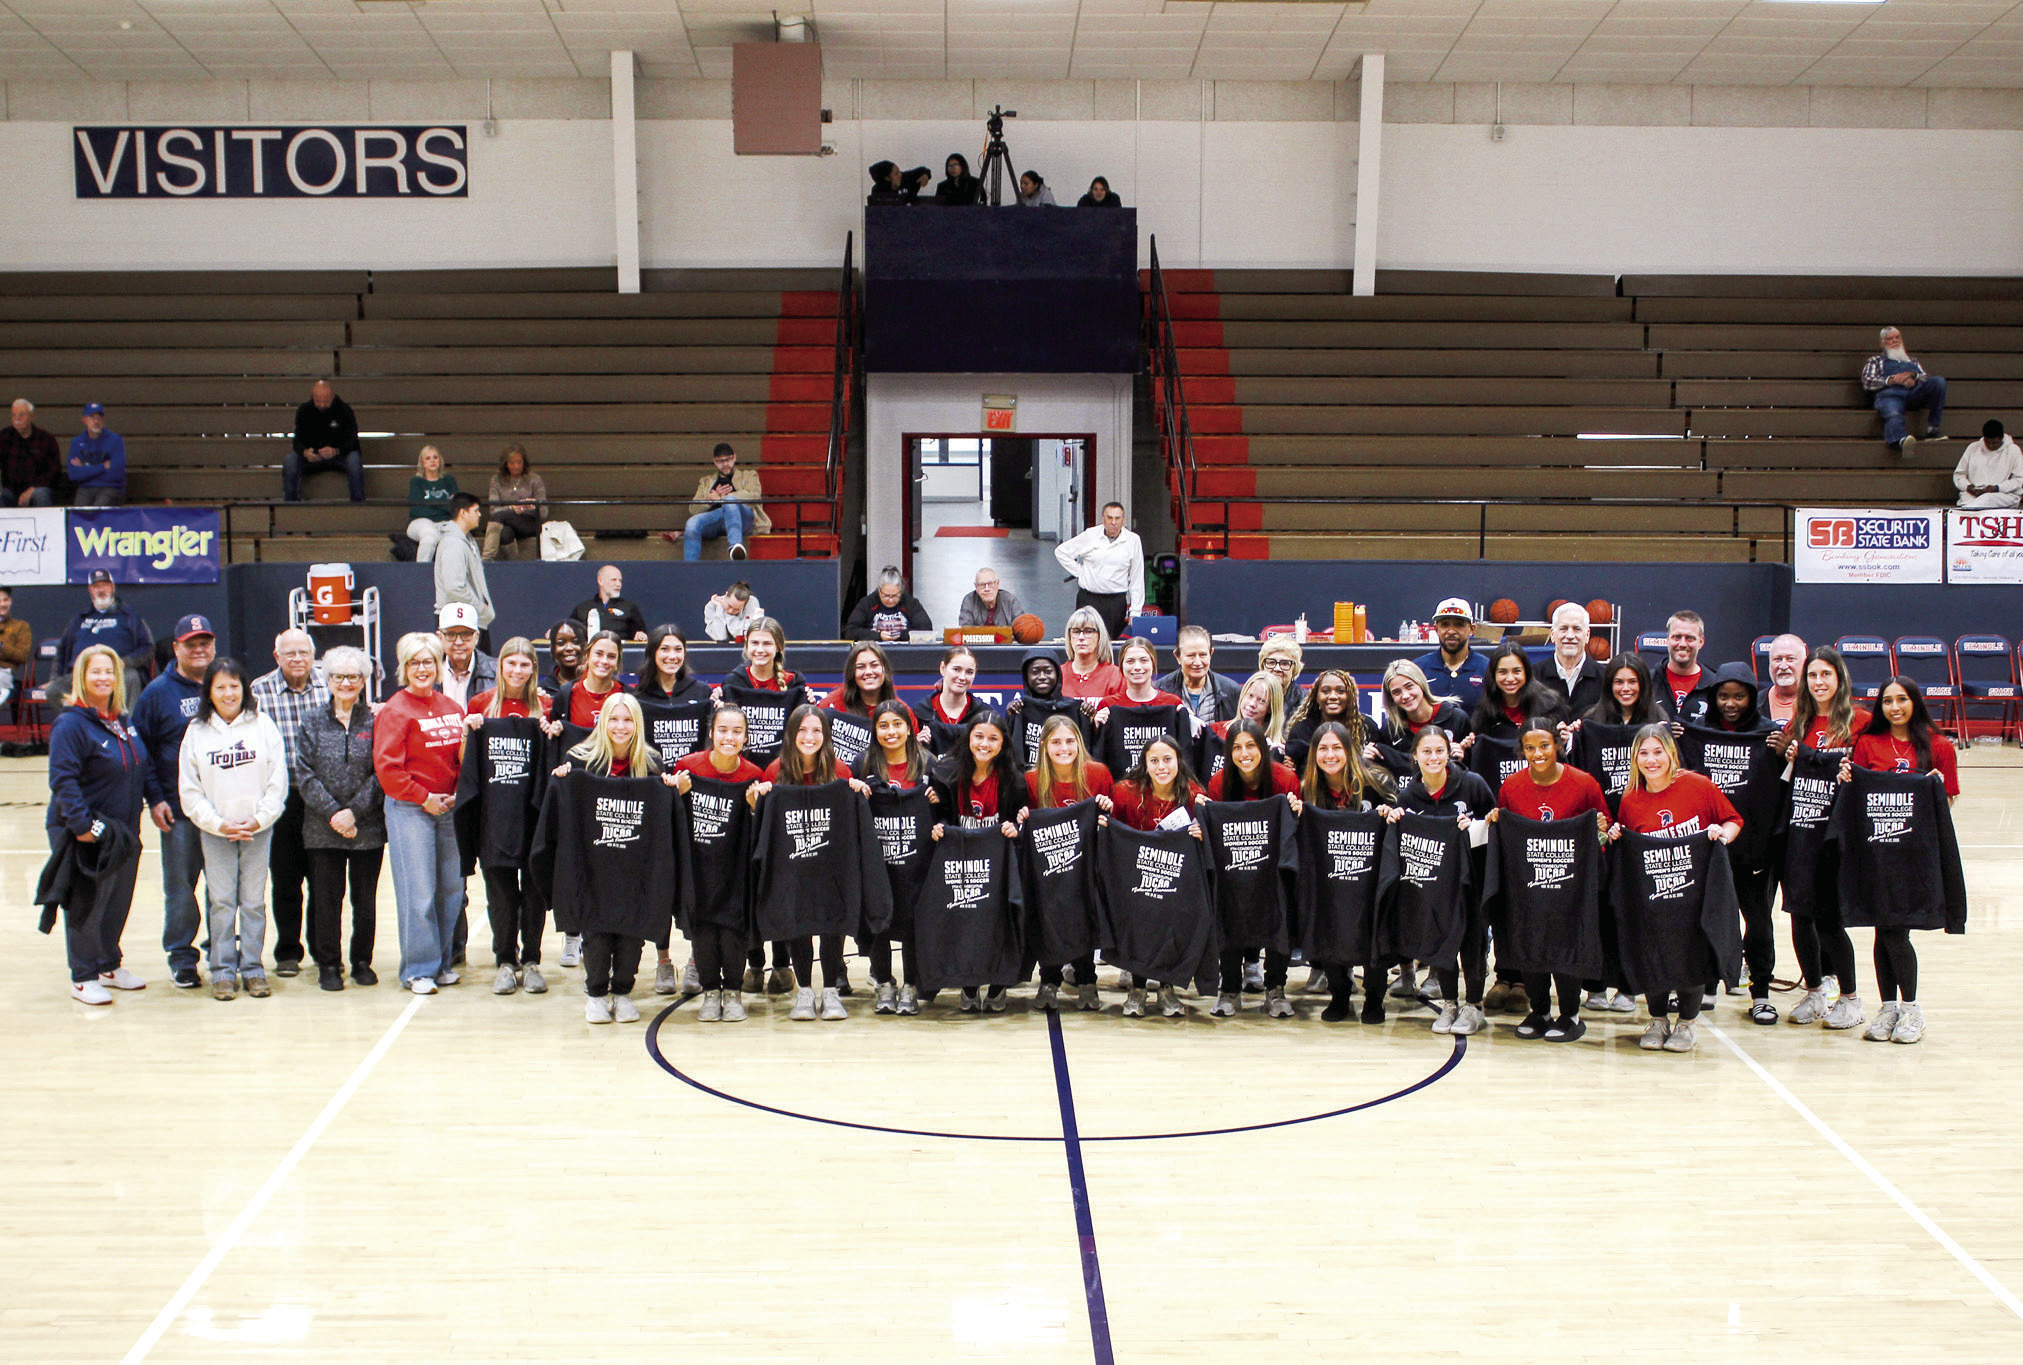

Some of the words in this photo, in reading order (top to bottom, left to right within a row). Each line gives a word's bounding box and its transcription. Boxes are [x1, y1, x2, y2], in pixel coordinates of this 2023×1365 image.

[76, 128, 467, 195] VISITORS
[987, 410, 1013, 430] EXIT
[1858, 519, 1928, 534] SECURITY
[1, 530, 49, 557] First
[74, 525, 213, 570] Wrangler
[1858, 535, 1890, 547] STATE
[1893, 535, 1928, 547] BANK
[316, 585, 333, 605] G
[457, 607, 464, 619] S
[191, 617, 203, 631] S
[962, 634, 995, 644] POSSESSION
[1643, 637, 1669, 647] SEMIN
[1963, 641, 2004, 651] SEMINOLE
[1842, 642, 1885, 652] SEMINOLE
[1900, 643, 1943, 653] SEMINOLE
[1926, 686, 1952, 696] STATE
[1988, 687, 2014, 697] STATE
[653, 719, 699, 733] SEMINOLE
[832, 729, 845, 739] STATE
[207, 750, 256, 767] Trojans
[1704, 744, 1751, 759] SEMINOLE
[1722, 757, 1750, 765] COLLEGE
[597, 797, 645, 815] SEMINOLE
[1867, 793, 1914, 807] SEMINOLE
[621, 818, 642, 826] SOCCER
[709, 815, 729, 823] SOCCER
[1676, 814, 1701, 838] STATE
[1033, 819, 1080, 843] SEMINOLE
[1222, 820, 1269, 836] SEMINOLE
[1035, 840, 1050, 849] STATE
[1053, 833, 1080, 844] COLLEGE
[1328, 830, 1375, 845] SEMINOLE
[1400, 832, 1446, 855] SEMINOLE
[1037, 844, 1061, 853] WOMEN'S
[1062, 838, 1080, 848] SOCCER
[1346, 844, 1374, 852] COLLEGE
[1526, 838, 1575, 852] SEMINOLE
[1138, 845, 1185, 867] SEMINOLE
[1400, 846, 1415, 855] STATE
[1415, 849, 1443, 864] COLLEGE
[1400, 852, 1420, 862] WOMEN'S
[1420, 857, 1441, 866] SOCCER
[944, 859, 990, 874] SEMINOLE
[1136, 864, 1161, 874] WOMEN'S
[1160, 869, 1181, 878] SOCCER
[1154, 861, 1181, 873] COLLEGE
[1645, 868, 1671, 876] WOMEN'S
[1671, 864, 1693, 873] SOCCER
